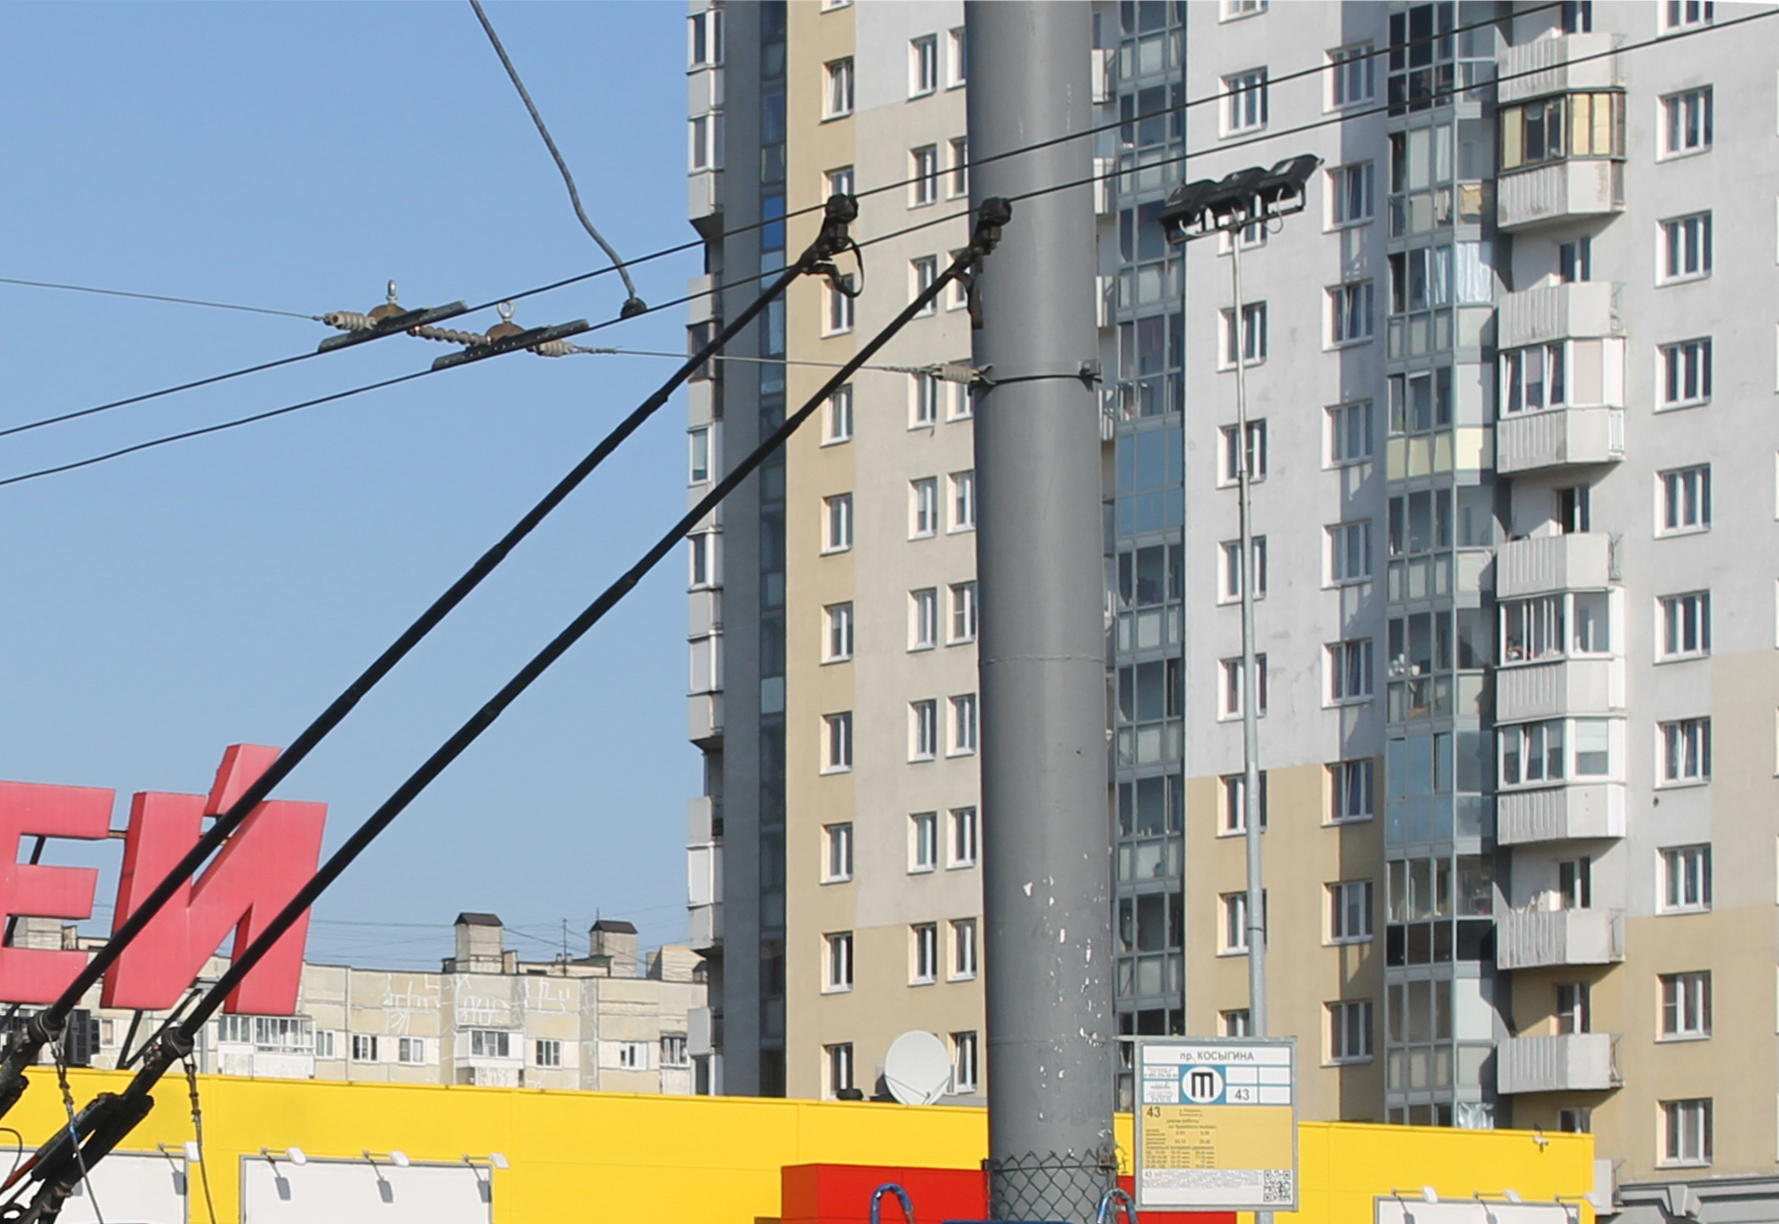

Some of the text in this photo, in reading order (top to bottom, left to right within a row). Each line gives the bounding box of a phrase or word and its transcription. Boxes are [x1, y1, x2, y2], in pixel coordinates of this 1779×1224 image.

[1180, 1051, 1255, 1062] пр. КОСЫГИНА
[1234, 1089, 1250, 1101] 43
[1146, 1106, 1161, 1118] 43
